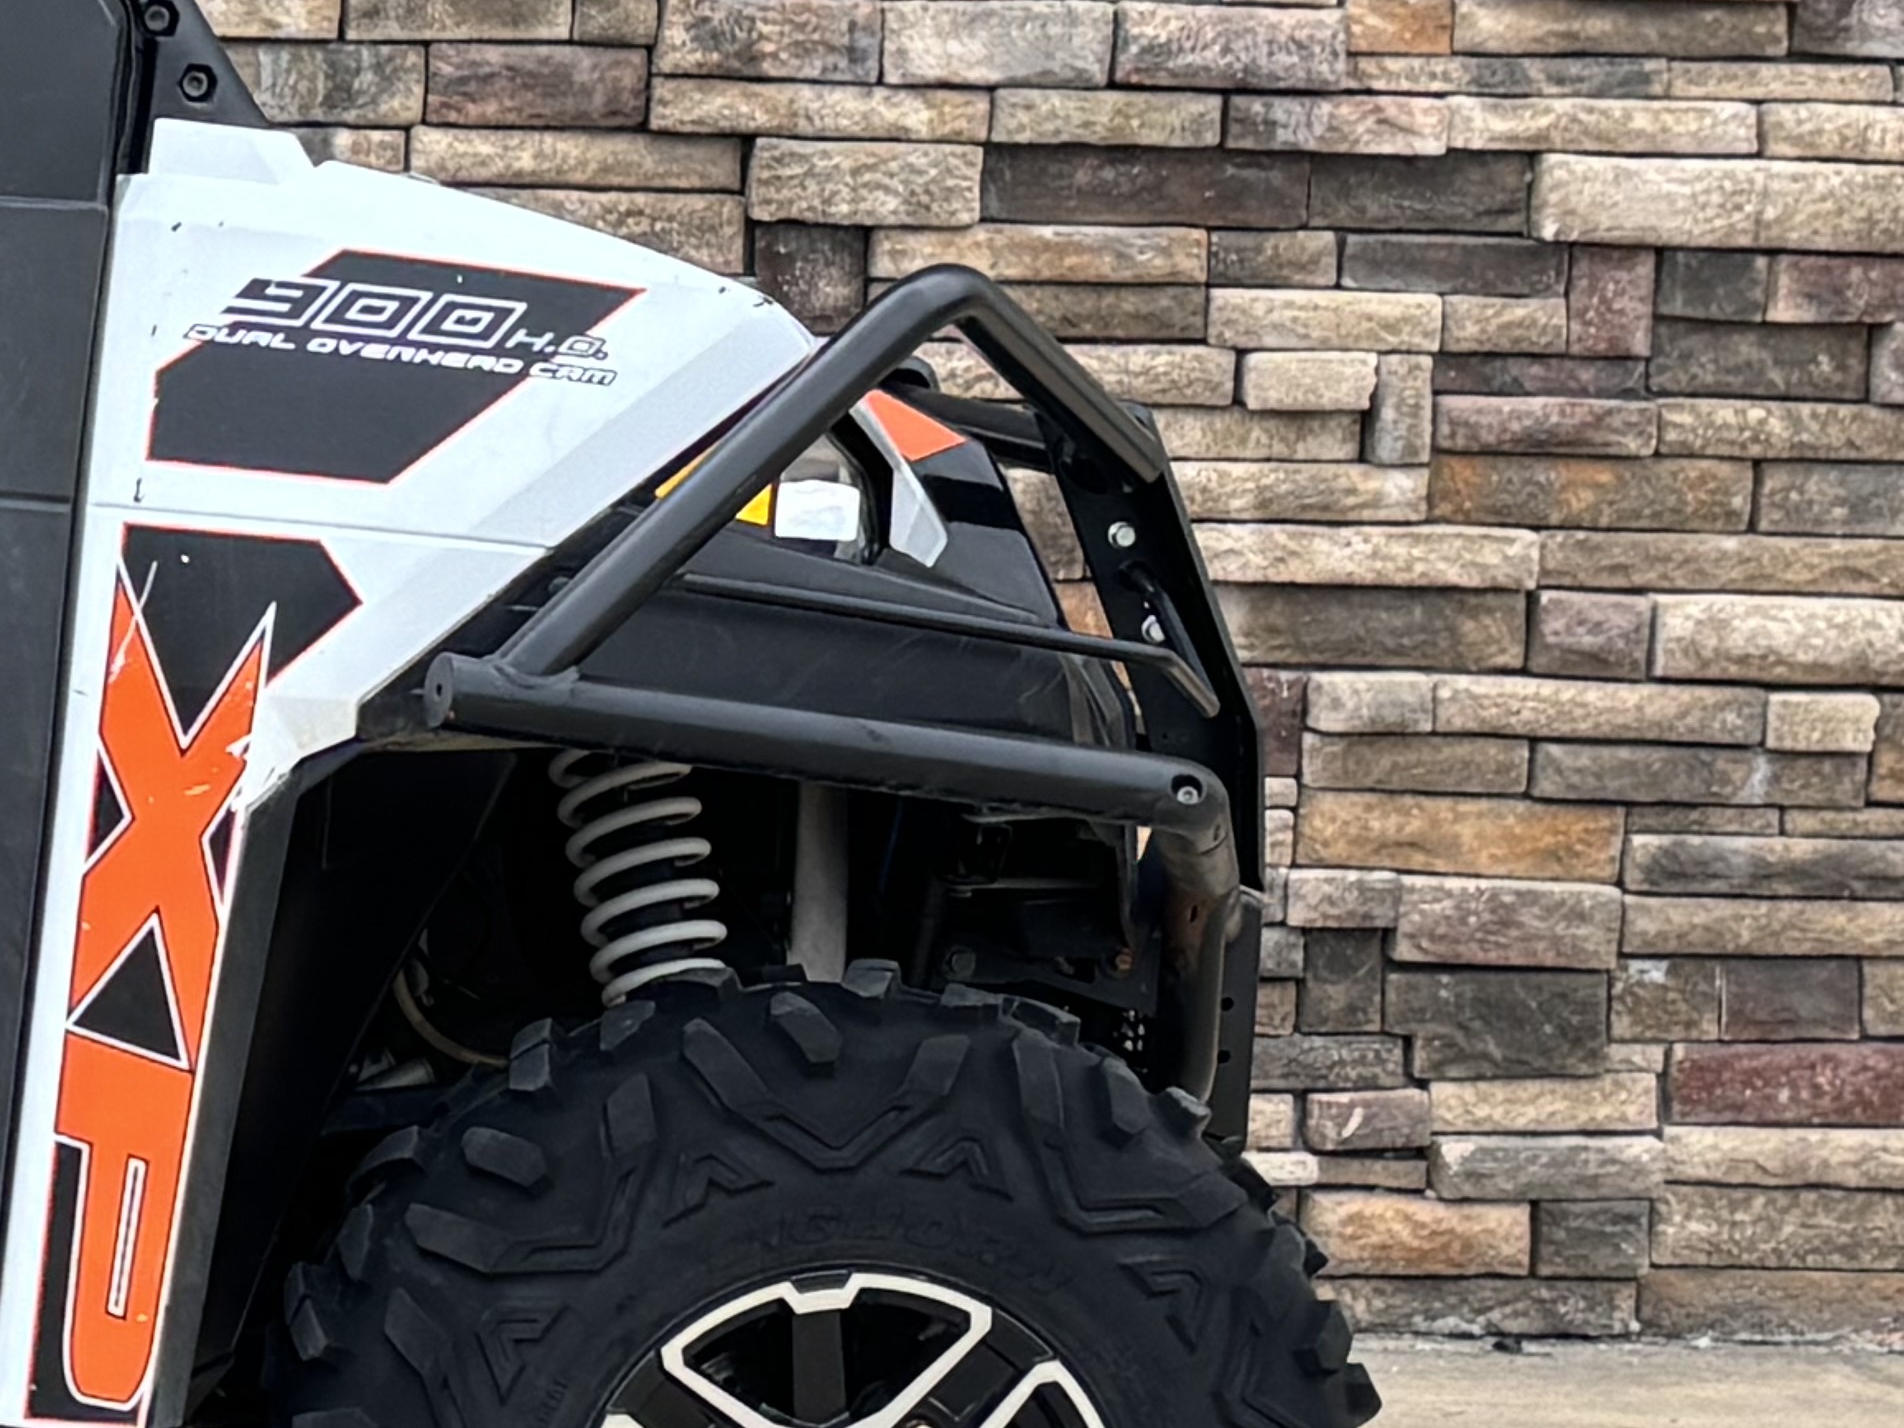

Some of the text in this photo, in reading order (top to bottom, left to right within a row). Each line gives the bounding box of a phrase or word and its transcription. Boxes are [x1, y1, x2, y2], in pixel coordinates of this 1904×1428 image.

[183, 323, 618, 386] DUAL OVERHEAD CAM
[219, 277, 609, 360] 900 H.O.
[52, 554, 276, 1411] XP
